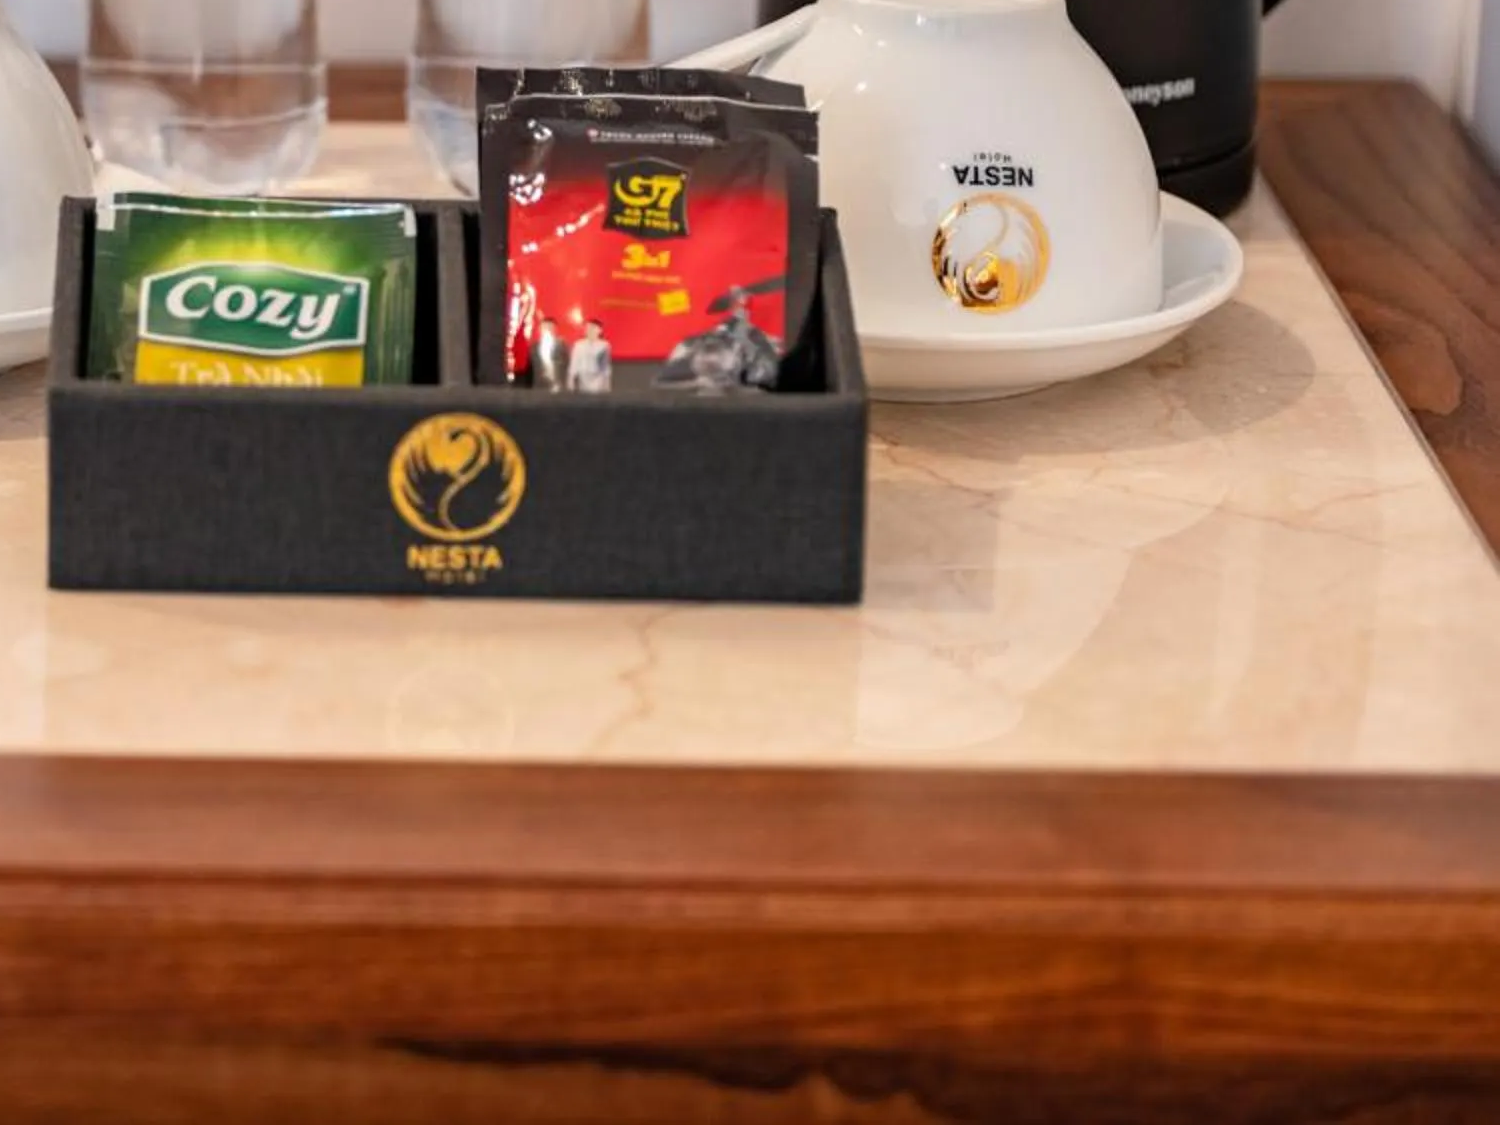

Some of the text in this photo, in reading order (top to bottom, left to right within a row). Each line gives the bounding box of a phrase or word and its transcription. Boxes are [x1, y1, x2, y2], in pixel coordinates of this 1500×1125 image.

[1122, 77, 1196, 107] oneyson
[613, 175, 682, 207] G7
[952, 165, 1035, 187] NESTA
[165, 276, 341, 340] Cozy
[406, 544, 503, 570] NESTA
